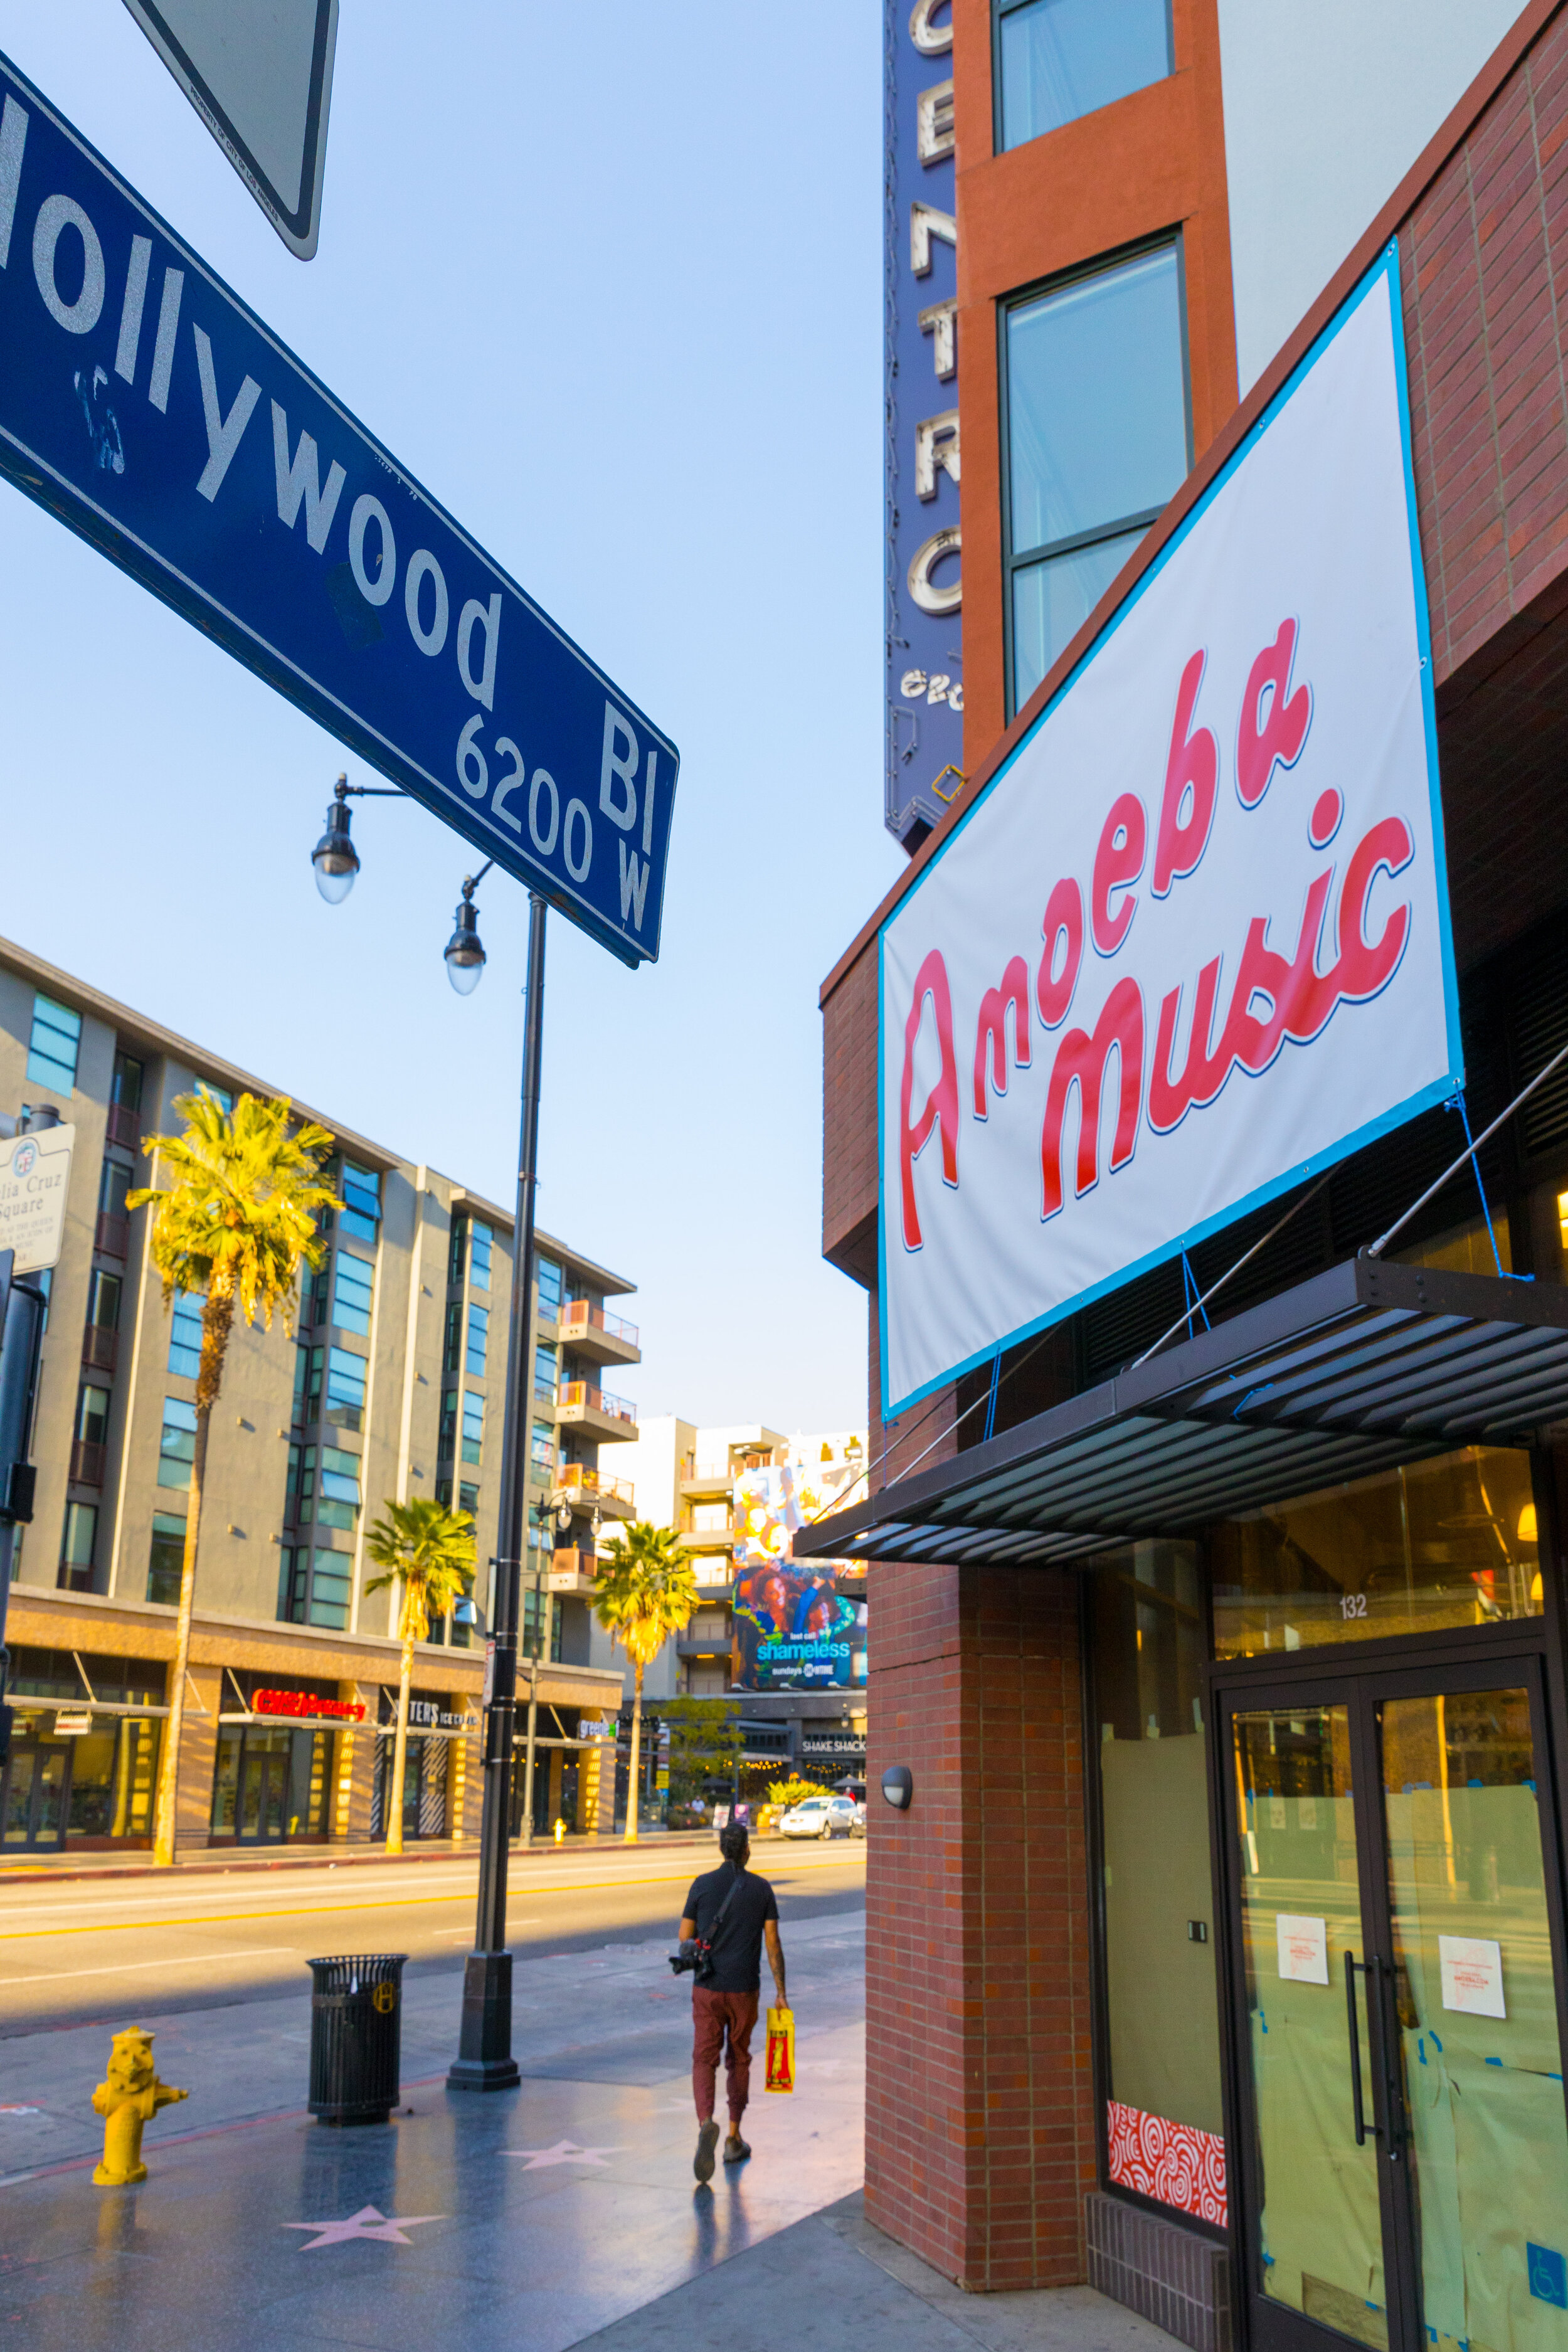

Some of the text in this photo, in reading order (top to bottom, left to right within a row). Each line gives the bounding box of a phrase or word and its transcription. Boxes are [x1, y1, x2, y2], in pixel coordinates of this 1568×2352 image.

[190, 85, 279, 222] PROPERTY OF CITY OF LOS ANGELES
[599, 699, 657, 856] Bl
[456, 714, 650, 932] 6200 W
[901, 615, 1313, 1250] Amoeba
[0, 1173, 61, 1199] lia Cruz
[1339, 1594, 1367, 1619] 132
[756, 1640, 850, 1660] shameless
[802, 1740, 867, 1752] SHAKE SHACK
